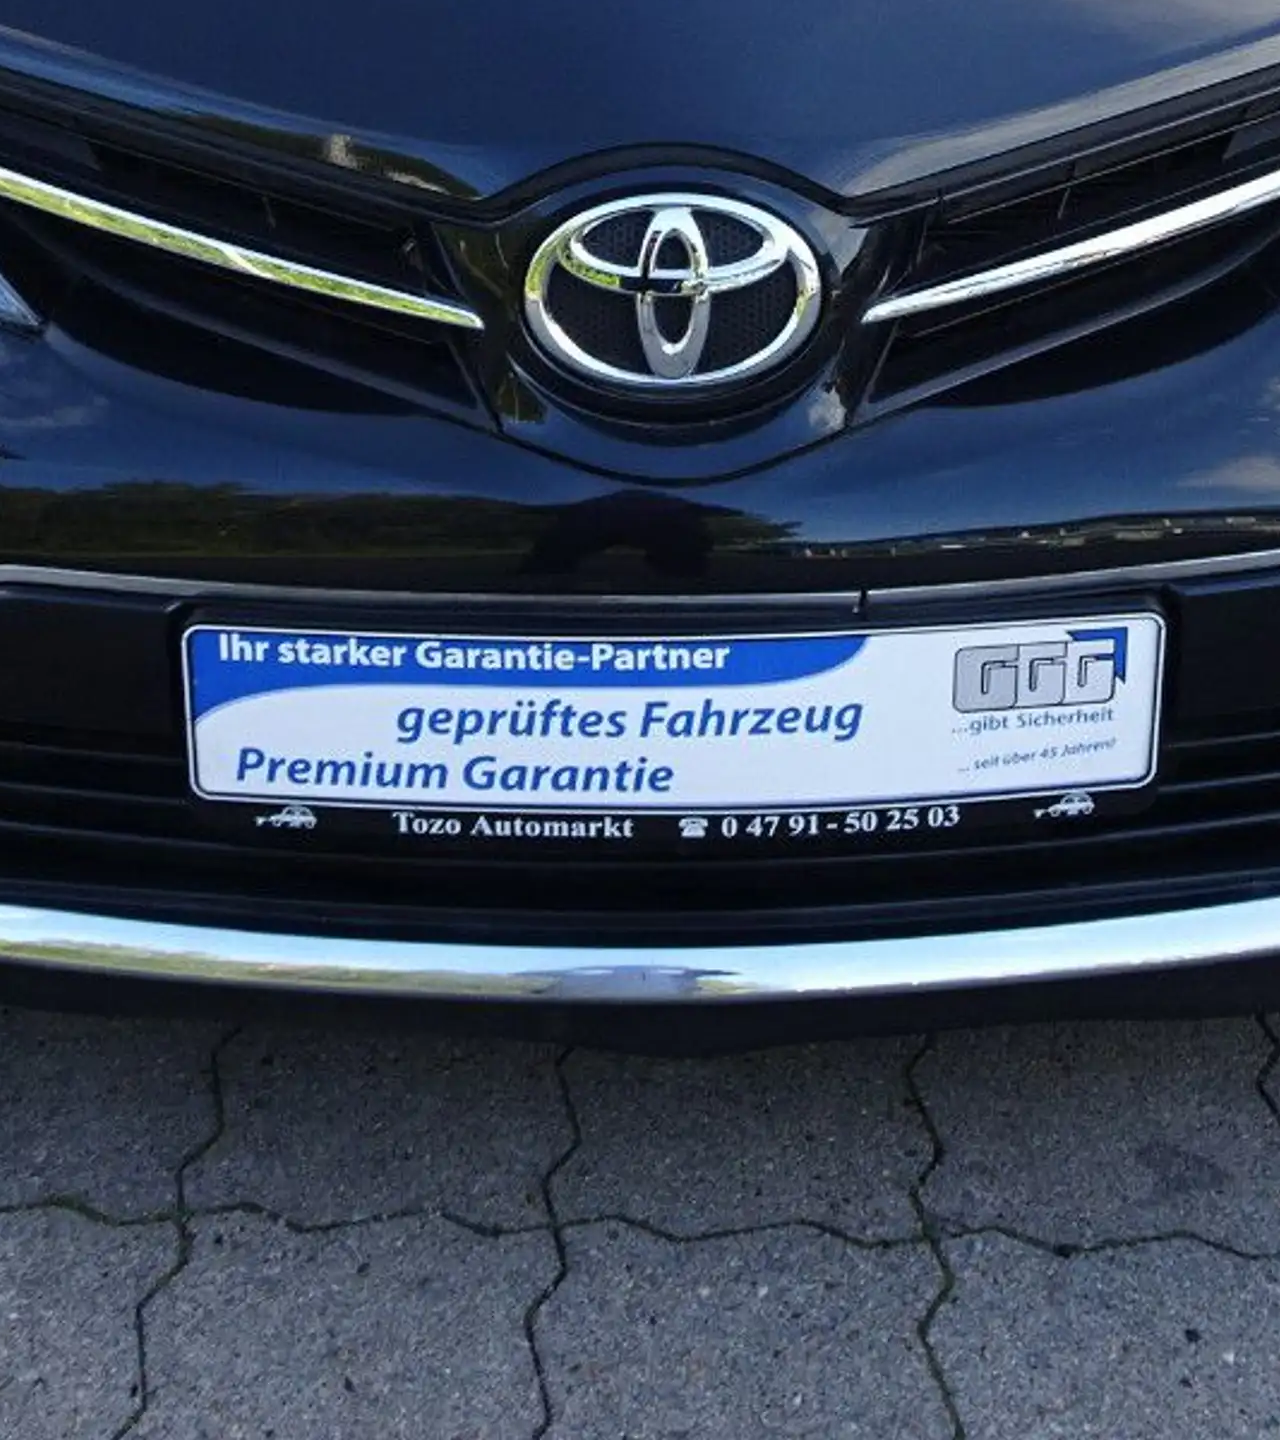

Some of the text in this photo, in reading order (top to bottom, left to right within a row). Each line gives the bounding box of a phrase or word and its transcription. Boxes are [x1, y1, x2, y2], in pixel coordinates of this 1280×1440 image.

[219, 632, 732, 671] Ihr starker Garantie-Partner
[952, 638, 1118, 714] GGG
[396, 698, 863, 744] geprüftes Fahrzeug
[1015, 705, 1114, 728] Sicherheit
[236, 747, 675, 793] Premium Garantie
[1039, 746, 1059, 759] 45
[392, 811, 635, 838] Tozo Automarkt
